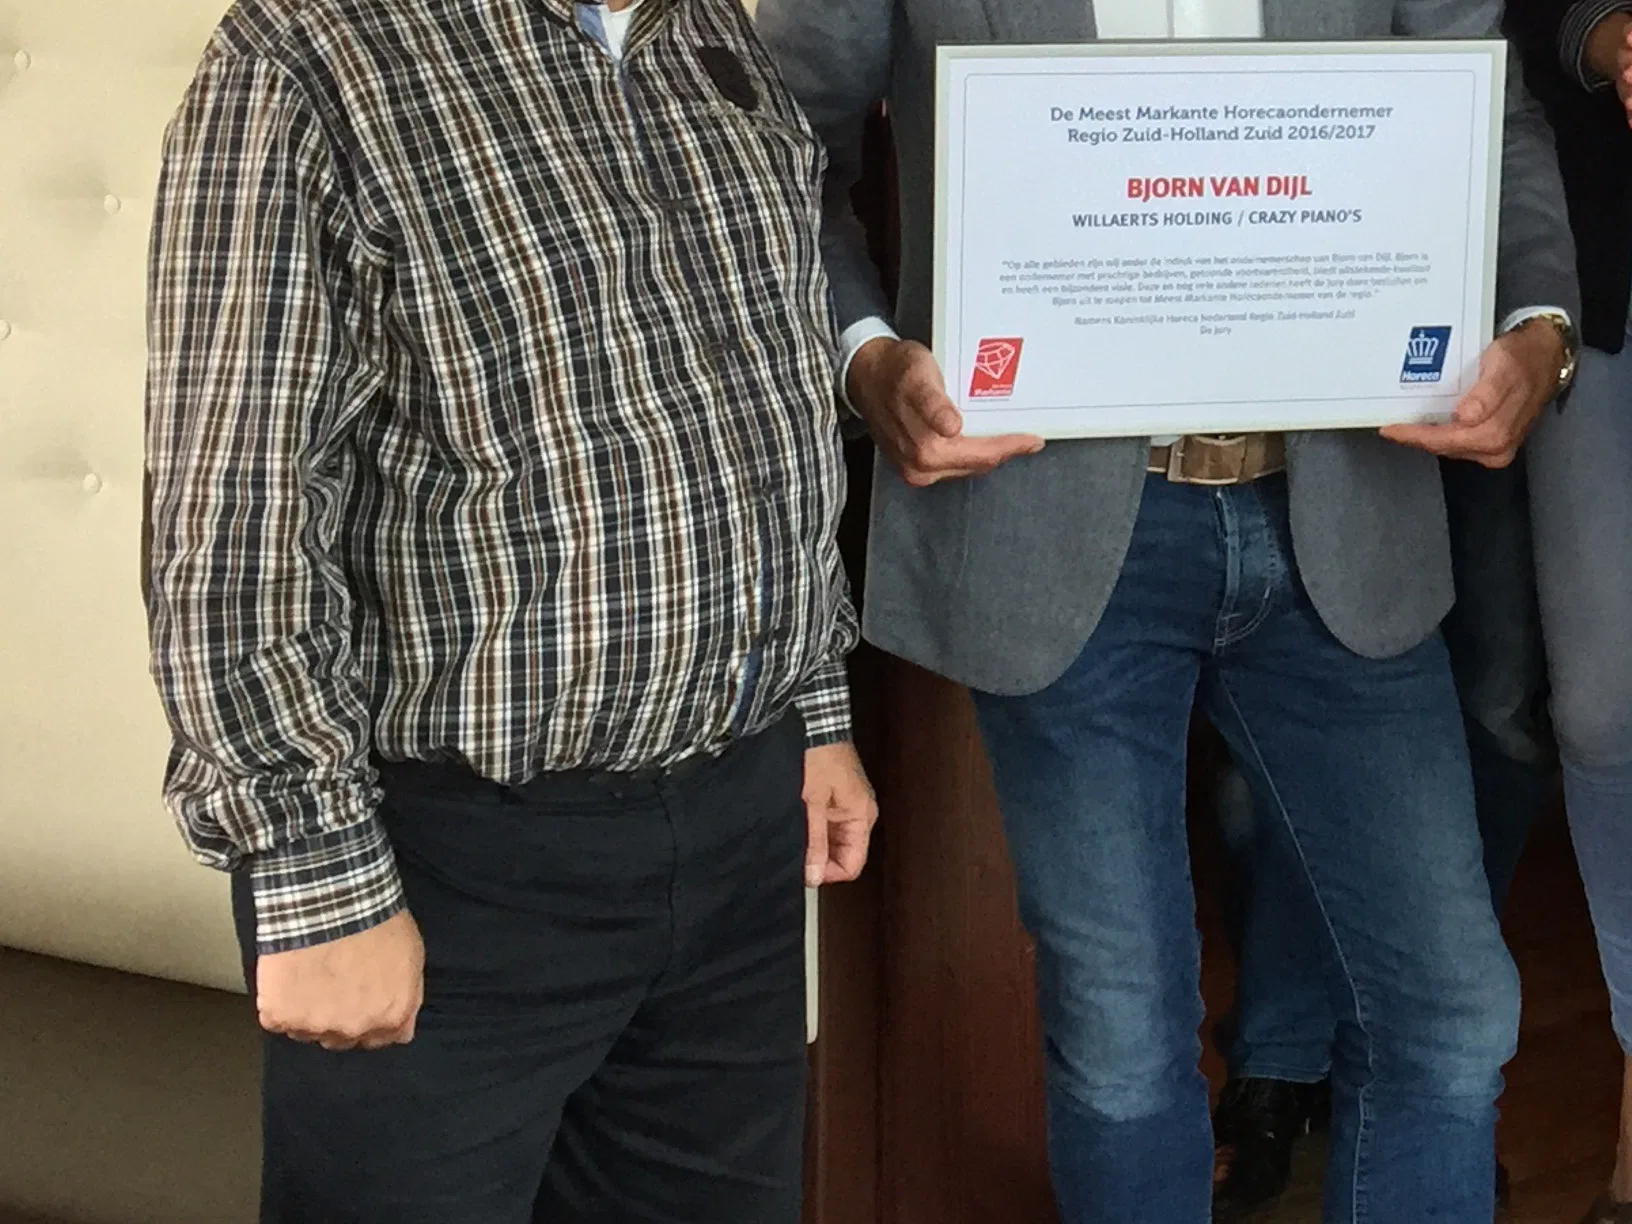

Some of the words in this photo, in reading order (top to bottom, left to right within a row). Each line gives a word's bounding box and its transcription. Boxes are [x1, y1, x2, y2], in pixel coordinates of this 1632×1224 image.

[1050, 106, 1073, 121] De
[1078, 106, 1131, 121] Meest
[1135, 105, 1219, 120] Markante
[1224, 104, 1394, 120] Horecaondernemer
[1067, 128, 1118, 146] Regio
[1122, 126, 1240, 142] Zuid-Holland
[1244, 125, 1283, 140] Zuid
[1287, 124, 1376, 141] 2016/2017
[1126, 176, 1205, 203] BJORN
[1210, 176, 1260, 197] VAN
[1266, 175, 1313, 200] DIJL
[1072, 212, 1159, 227] WILLAERTS
[1163, 211, 1232, 226] HOLDING
[1248, 209, 1297, 225] CRAZY
[1301, 208, 1362, 223] PIANO'S
